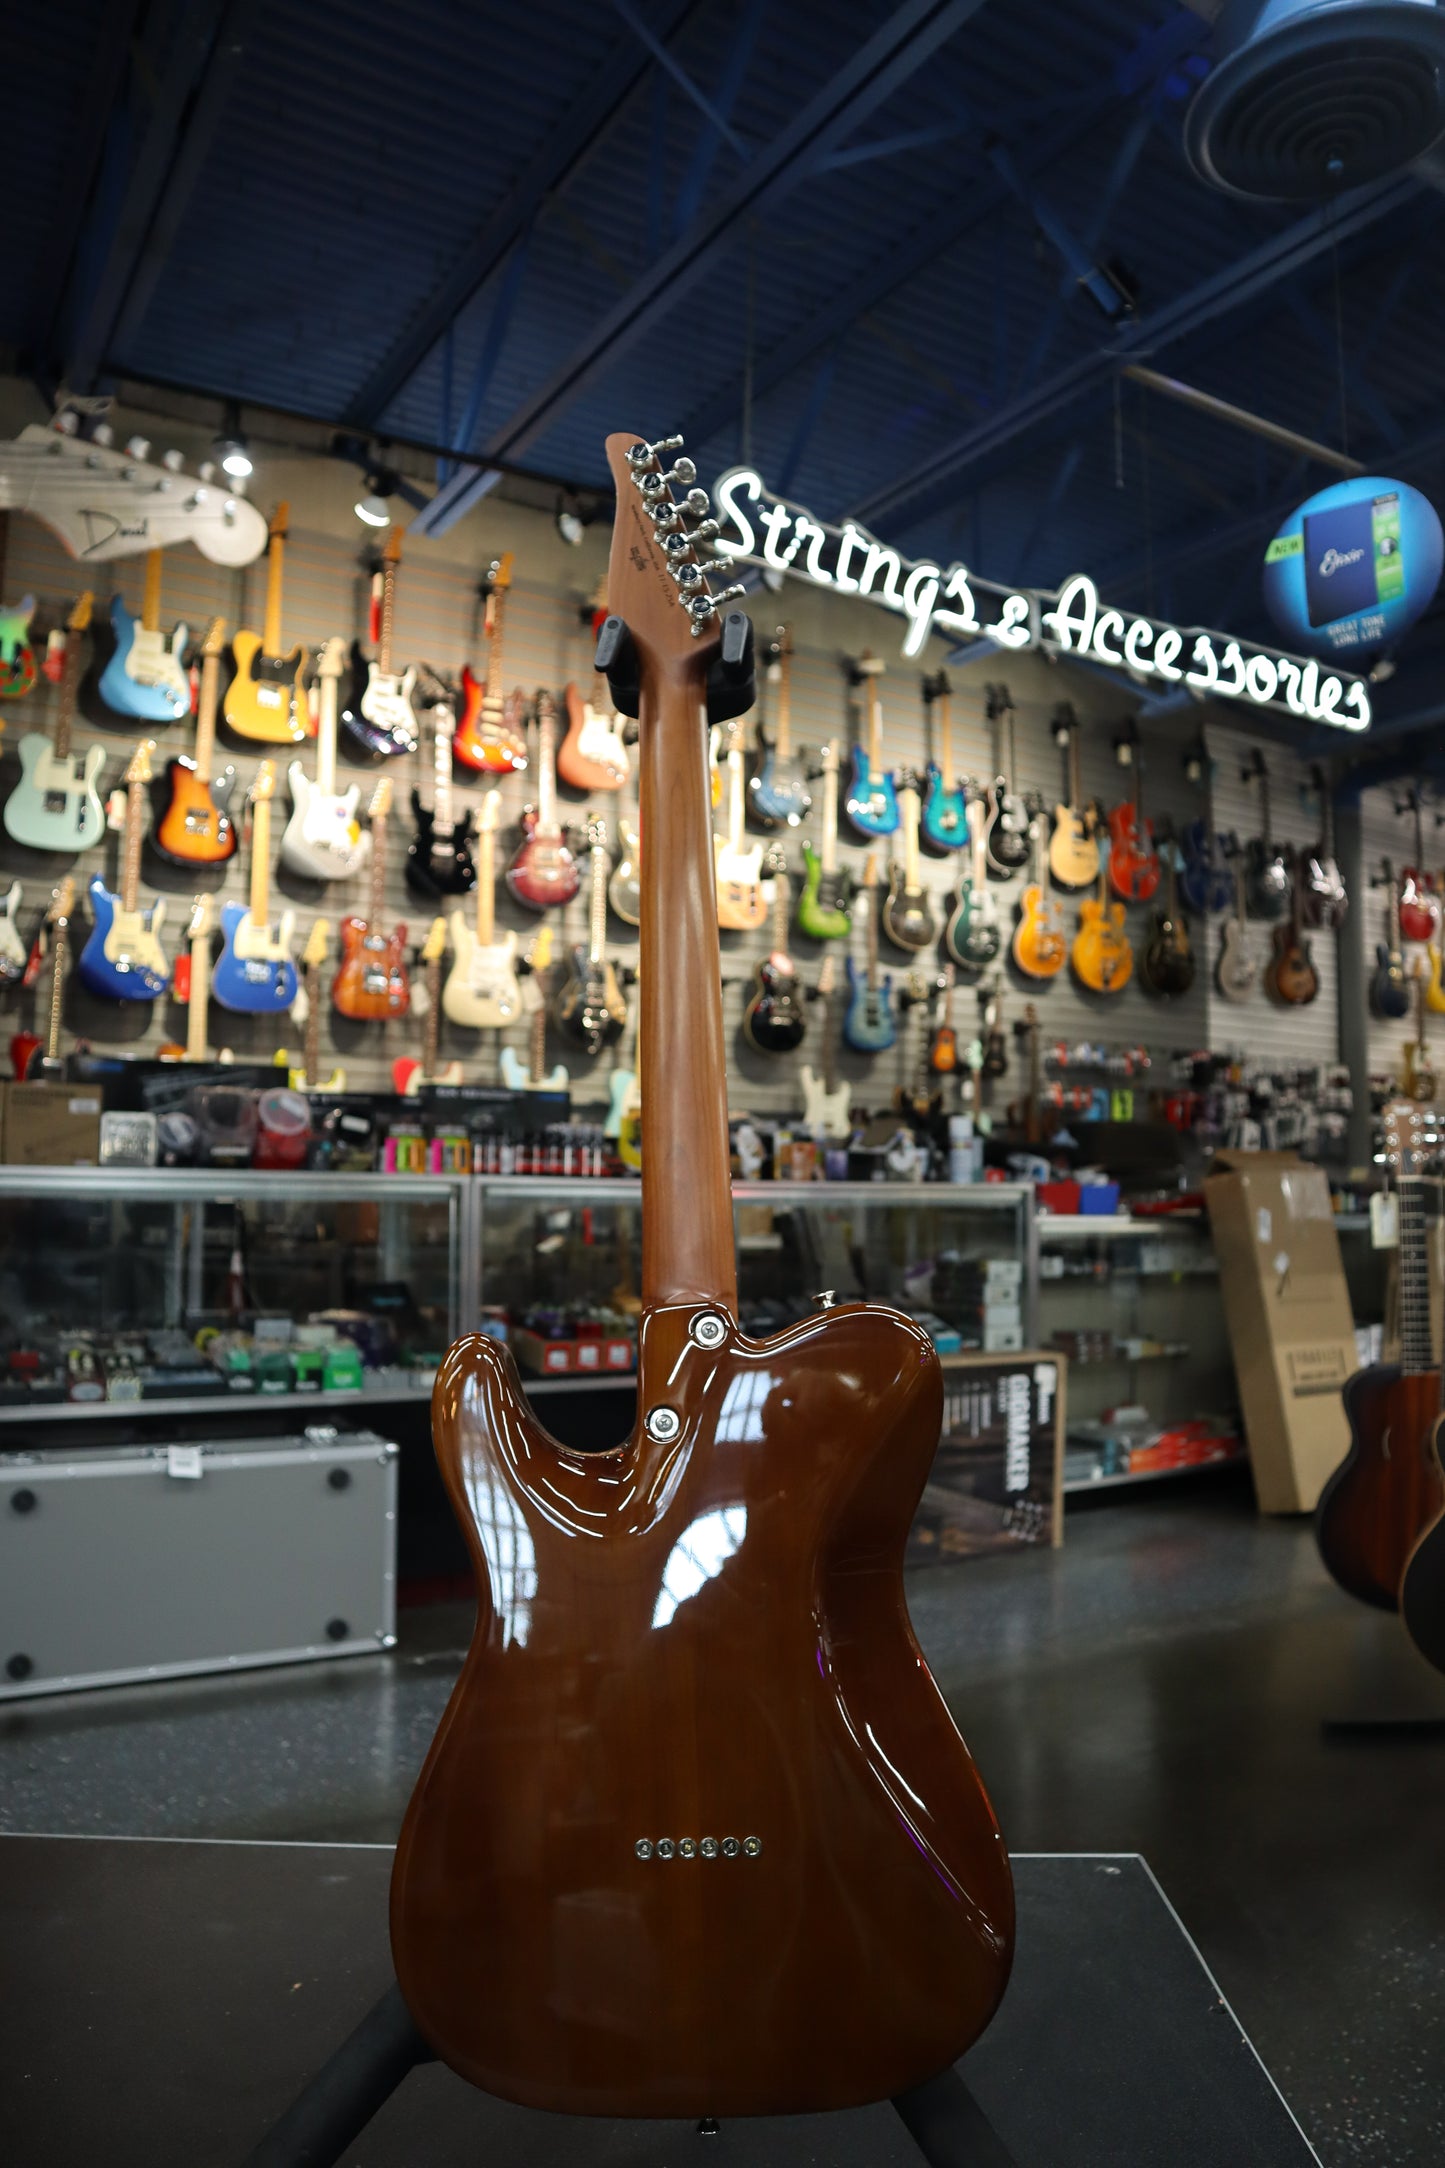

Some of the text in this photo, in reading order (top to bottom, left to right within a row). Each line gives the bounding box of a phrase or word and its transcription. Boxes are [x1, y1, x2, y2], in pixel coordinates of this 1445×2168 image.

[714, 469, 1373, 732] Strings & Accessories
[1318, 548, 1365, 577] Elixir
[1006, 1374, 1030, 1491] GIGMAKER
